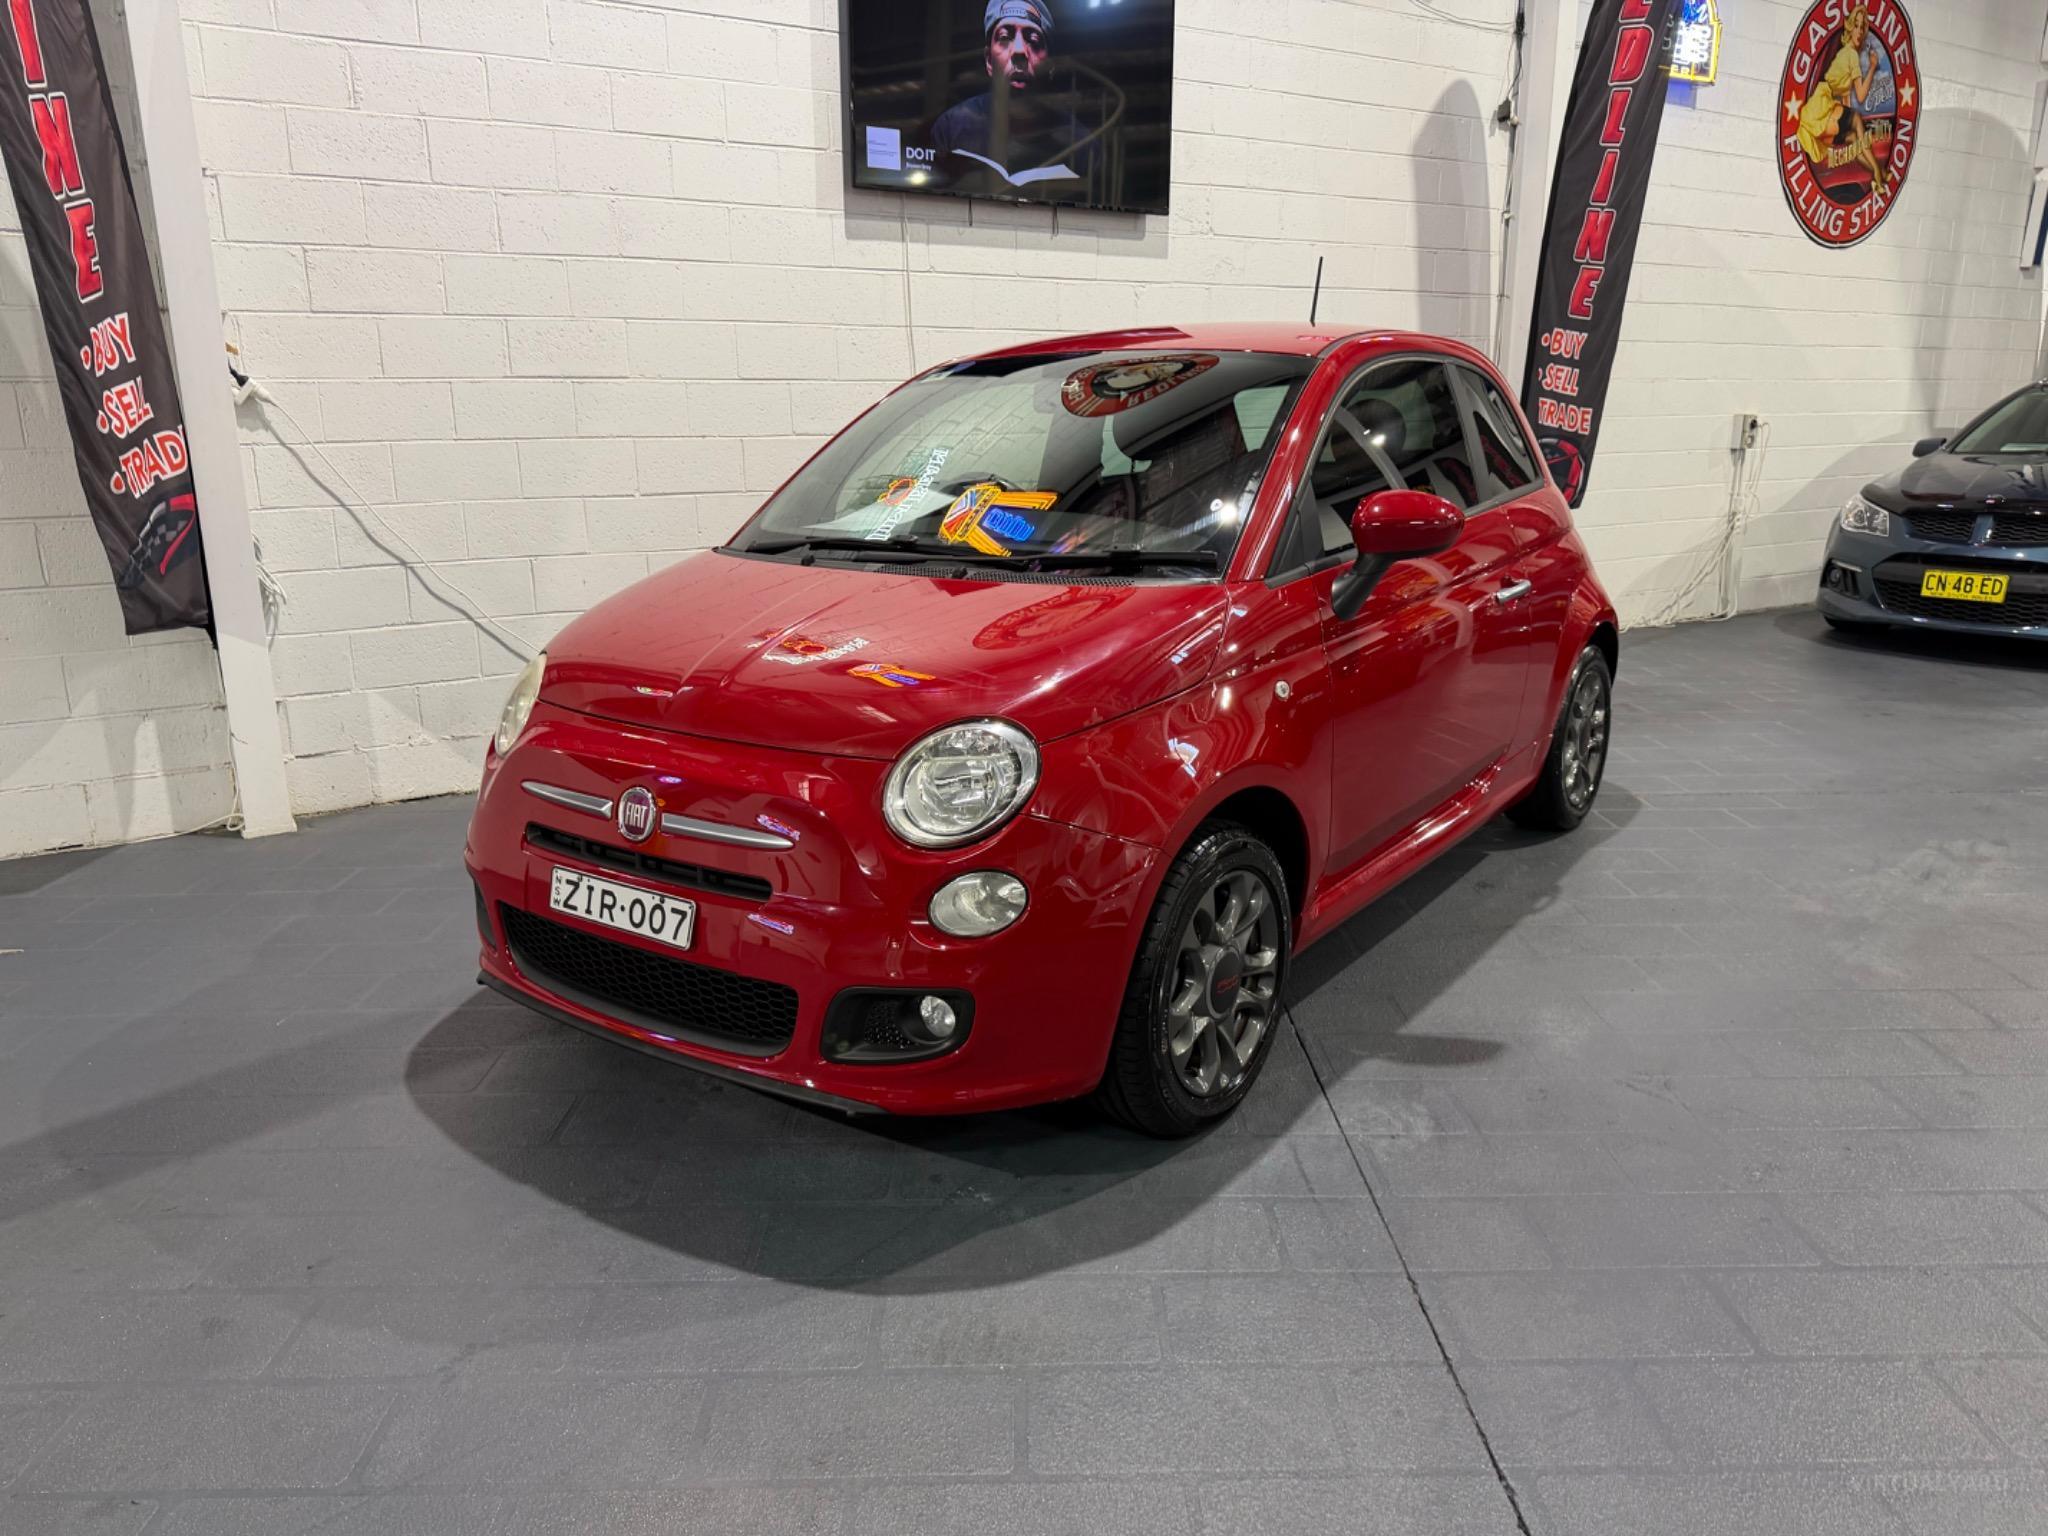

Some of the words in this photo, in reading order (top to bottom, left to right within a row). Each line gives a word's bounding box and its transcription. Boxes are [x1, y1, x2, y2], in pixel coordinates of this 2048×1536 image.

[1785, 133, 1846, 236] FILLING
[90, 312, 137, 377] BUY
[1550, 328, 1588, 360] BUY
[1541, 363, 1580, 397] SELL
[1538, 397, 1593, 436] TRADE
[119, 424, 188, 499] TRAD
[624, 801, 648, 829] FIAT
